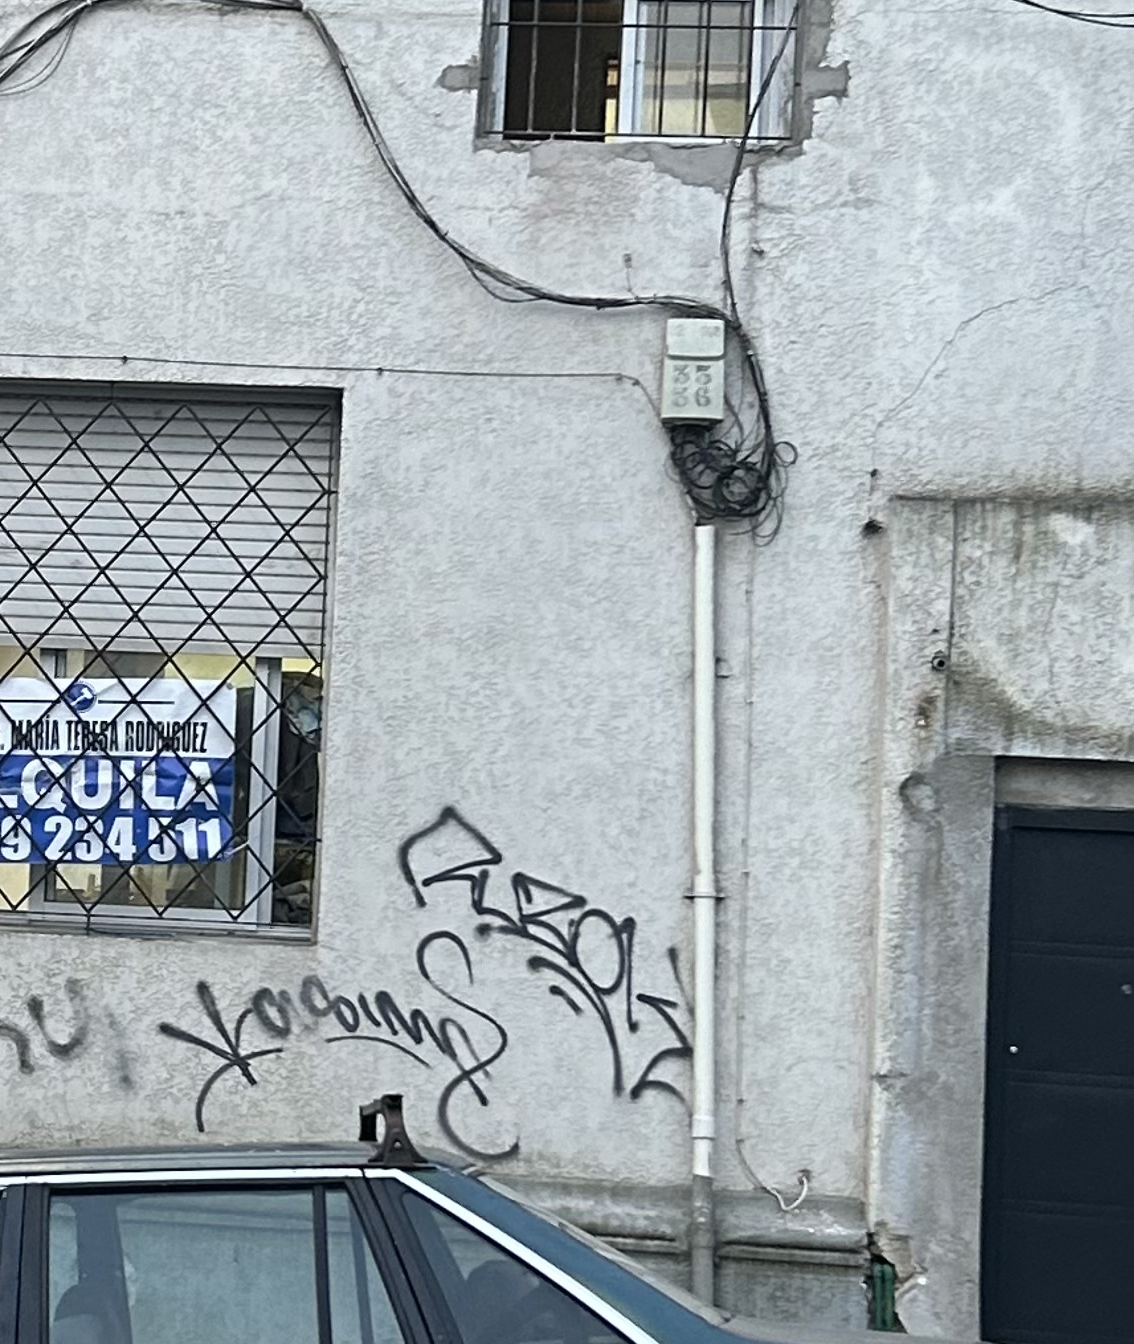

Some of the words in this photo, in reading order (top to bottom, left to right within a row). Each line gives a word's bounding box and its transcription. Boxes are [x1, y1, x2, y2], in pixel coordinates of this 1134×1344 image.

[65, 720, 119, 752] TERESA
[43, 816, 136, 862] 234
[148, 817, 222, 862] 511
